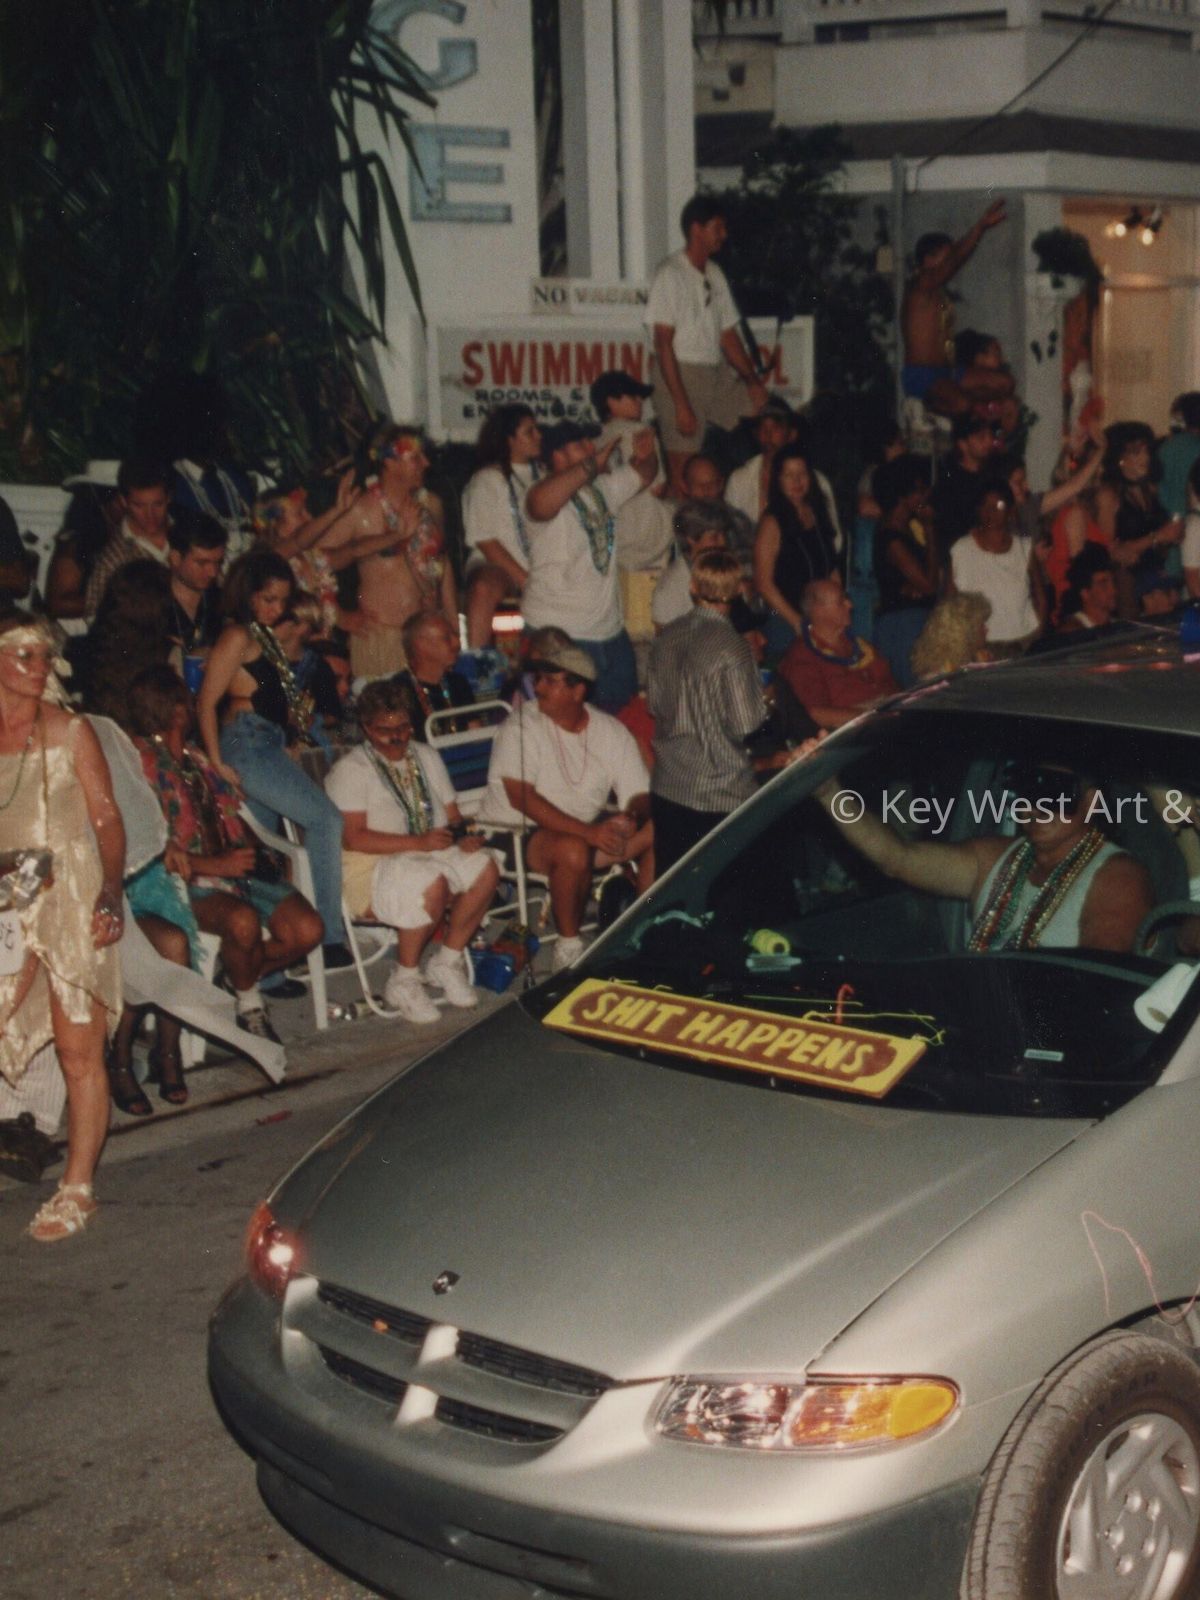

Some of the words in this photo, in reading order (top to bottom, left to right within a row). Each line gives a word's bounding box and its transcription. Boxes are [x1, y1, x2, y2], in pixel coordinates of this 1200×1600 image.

[533, 285, 568, 304] NO
[461, 340, 654, 388] SWIMMIN
[475, 388, 553, 402] ROOMS
[570, 388, 583, 401] &
[582, 991, 677, 1035] SHIT
[680, 1009, 876, 1075] HAPPENS
